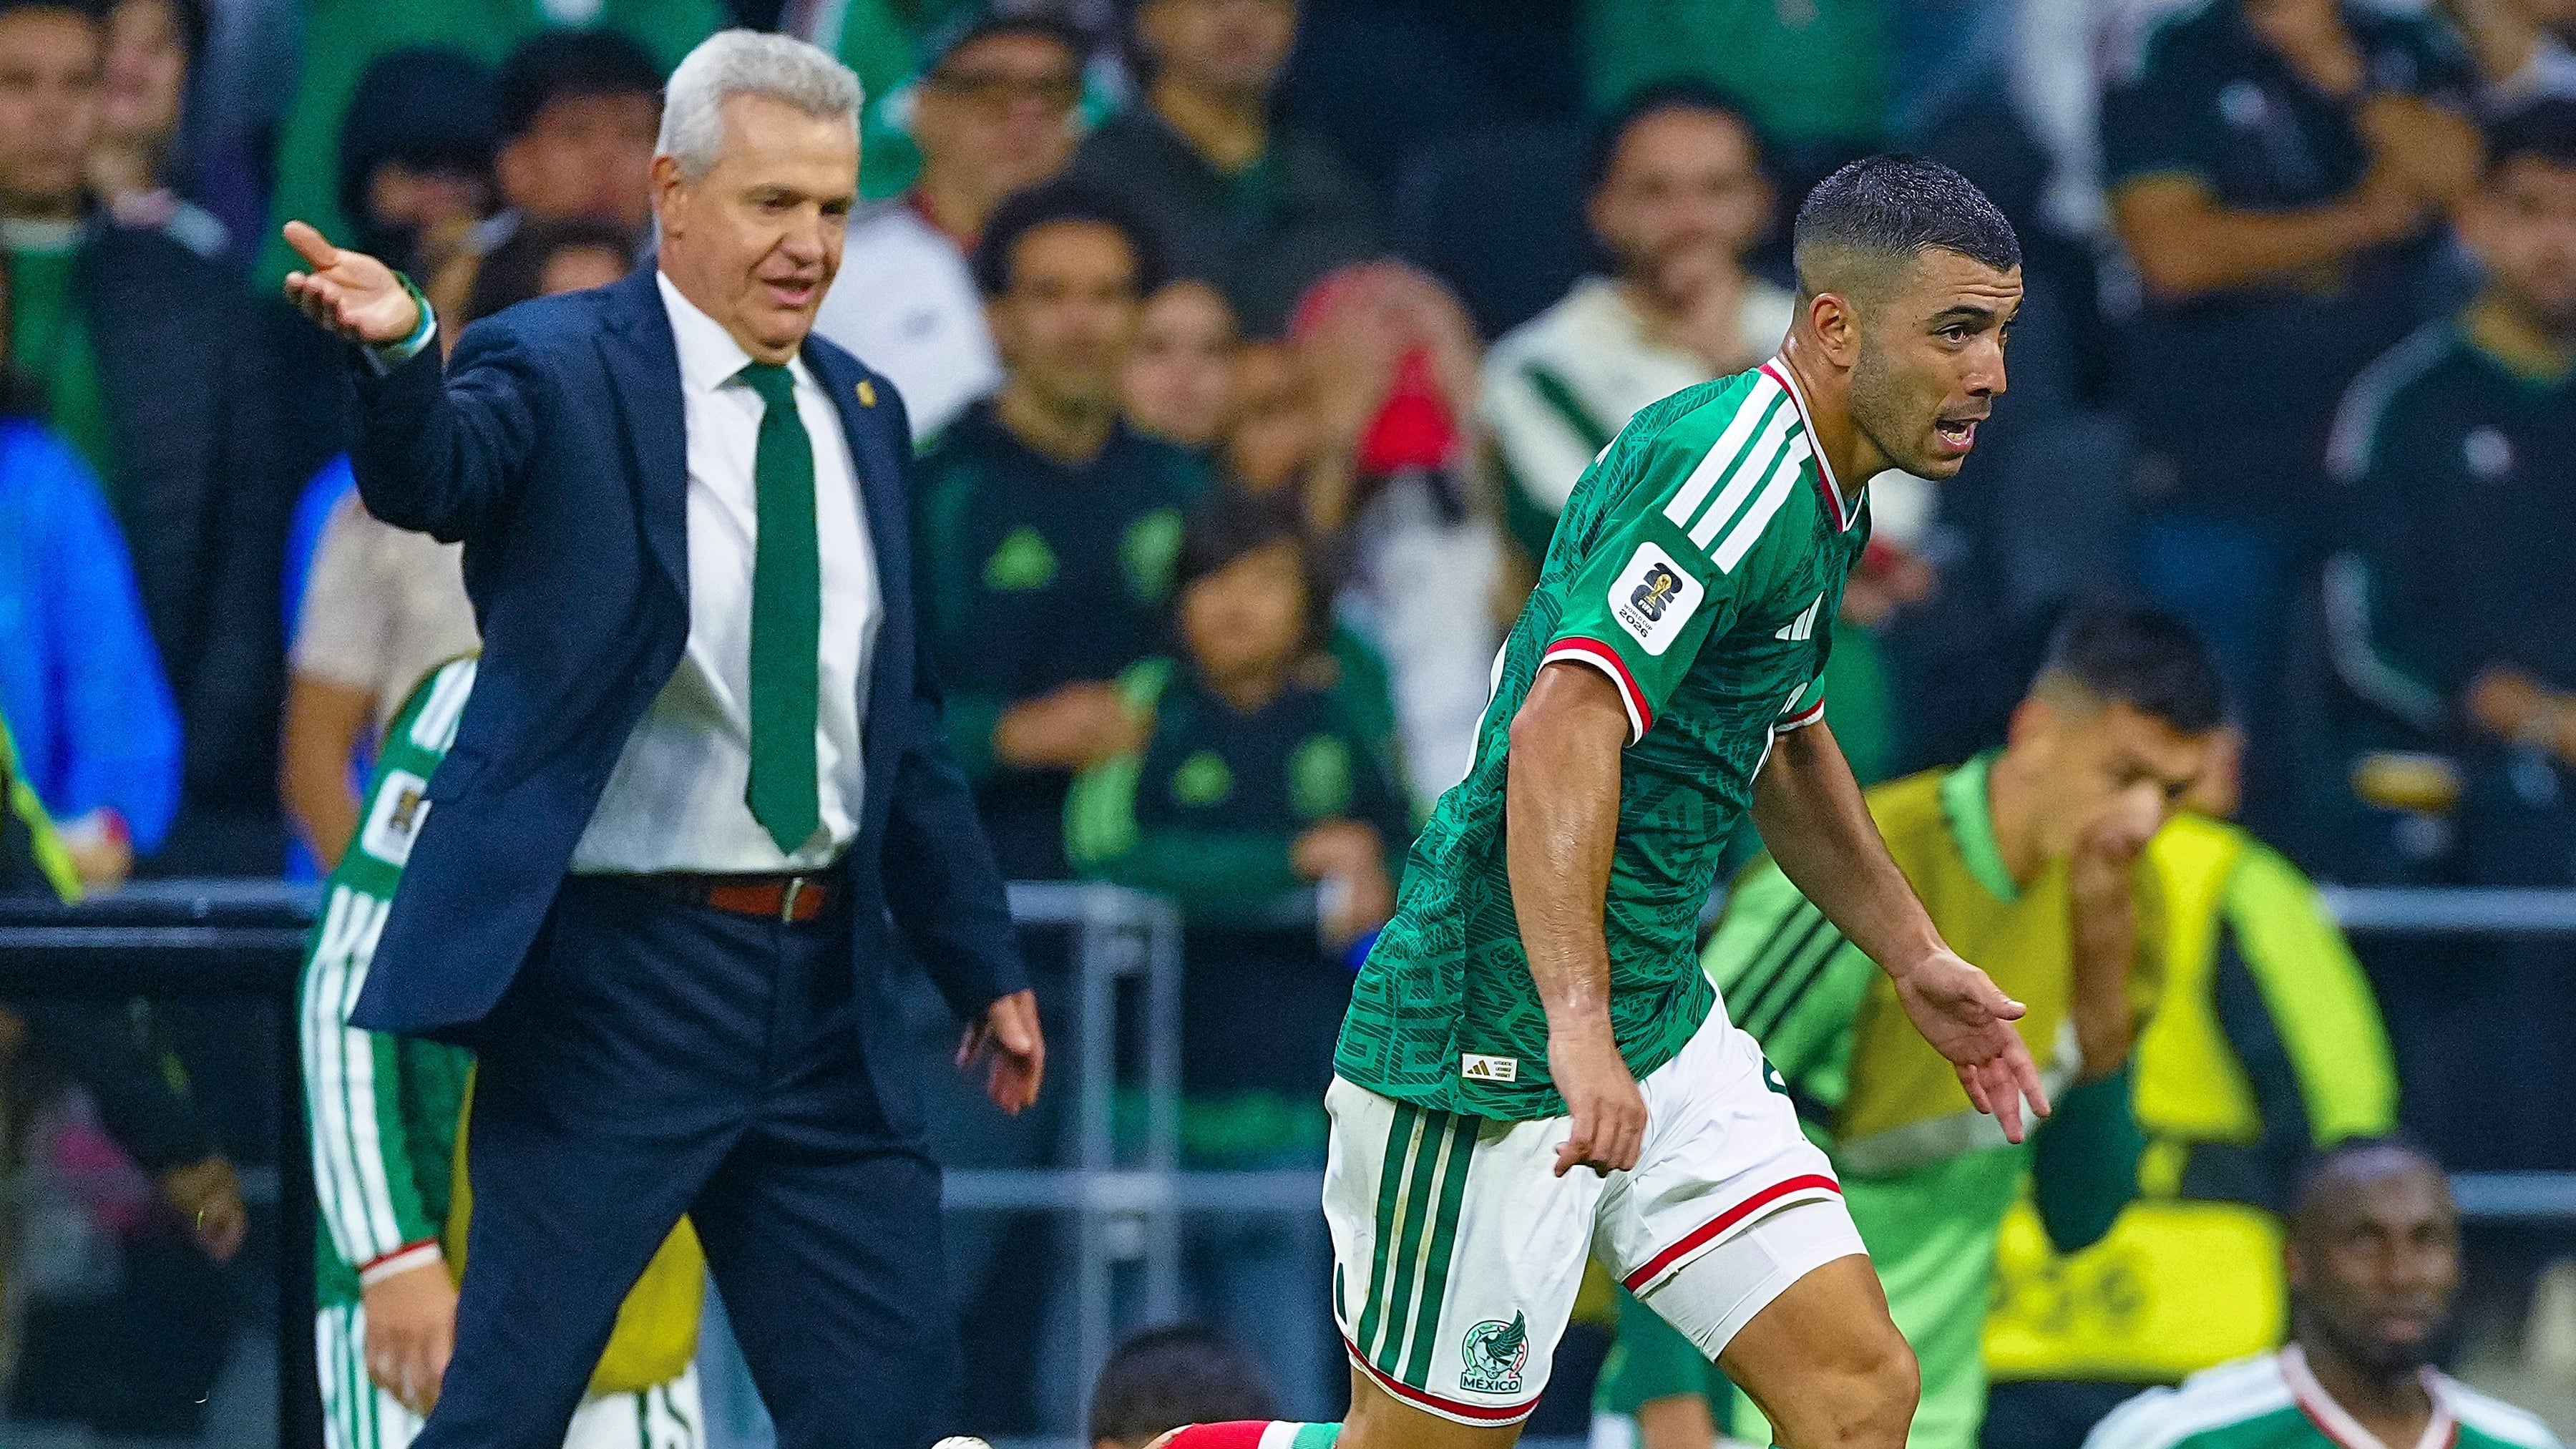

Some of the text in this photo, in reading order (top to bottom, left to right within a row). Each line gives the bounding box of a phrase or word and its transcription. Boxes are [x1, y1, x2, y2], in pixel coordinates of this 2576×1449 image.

[1619, 608, 1649, 638] 2026
[1624, 602, 1653, 630] WORLD CUP
[1463, 1377, 1518, 1390] MÉXICO
